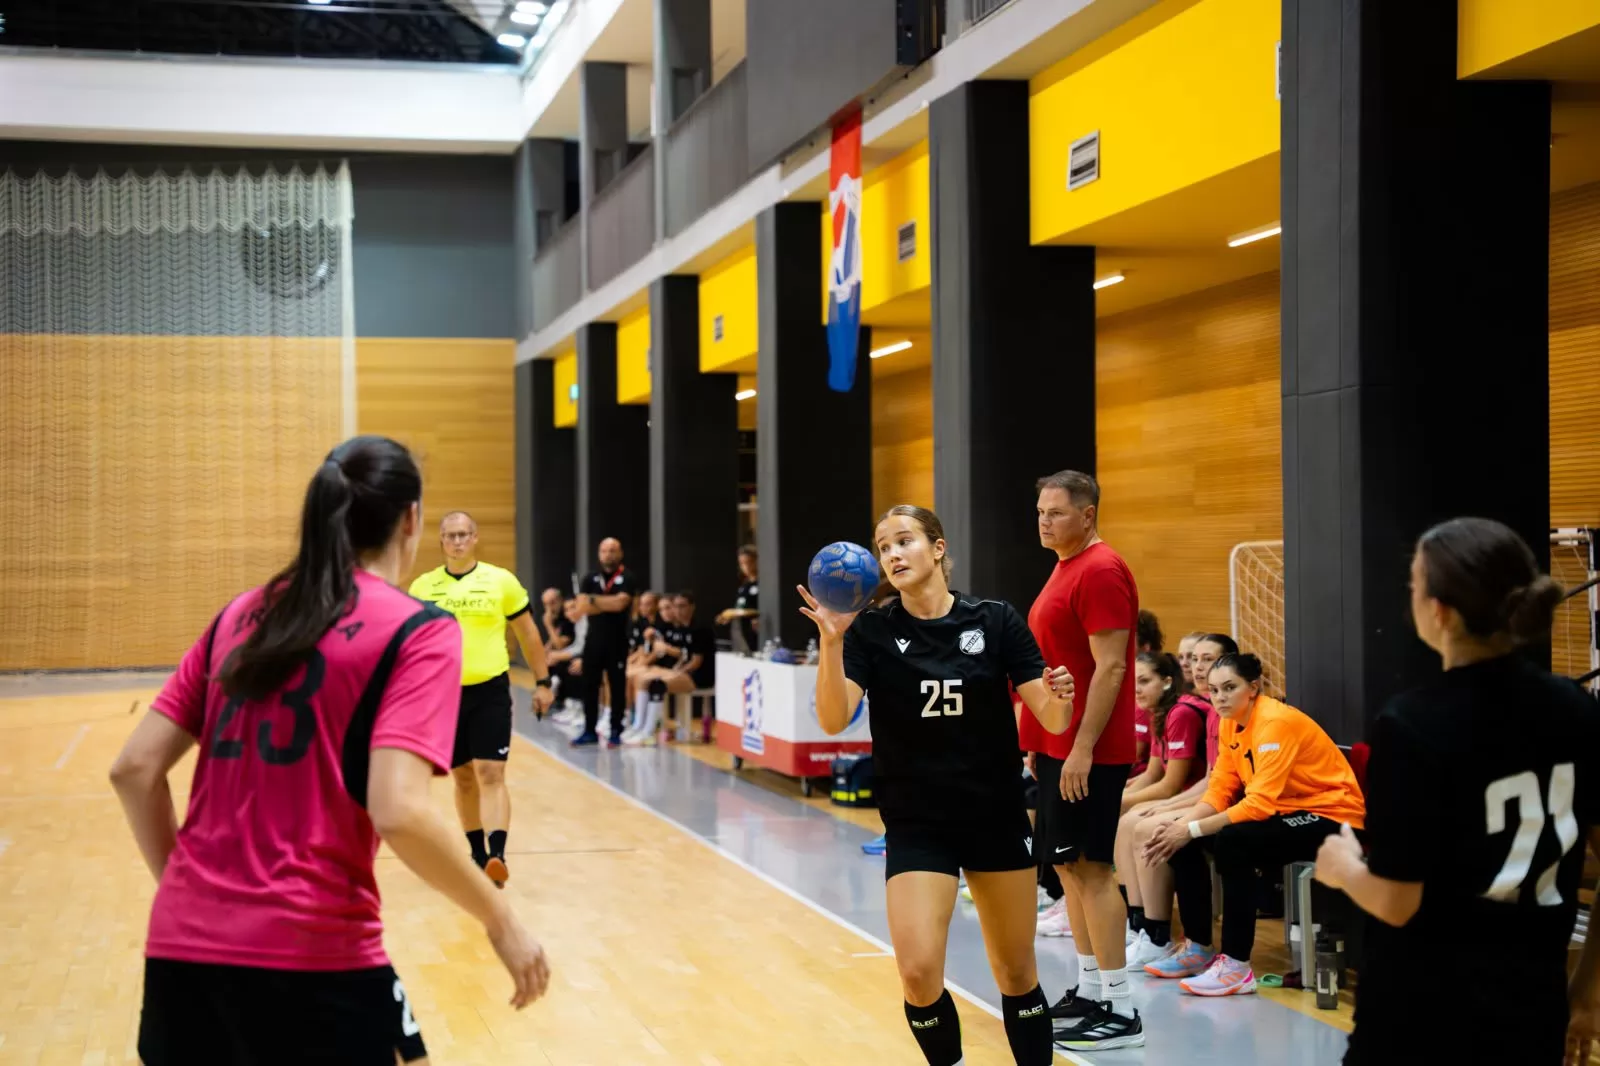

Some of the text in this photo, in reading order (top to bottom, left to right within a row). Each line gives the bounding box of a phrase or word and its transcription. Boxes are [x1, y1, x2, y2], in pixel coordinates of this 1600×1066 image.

[920, 678, 963, 718] 25
[1243, 748, 1256, 776] 1
[1480, 762, 1580, 907] 21
[911, 1016, 939, 1028] SELECT
[1017, 1004, 1044, 1016] SELECT
